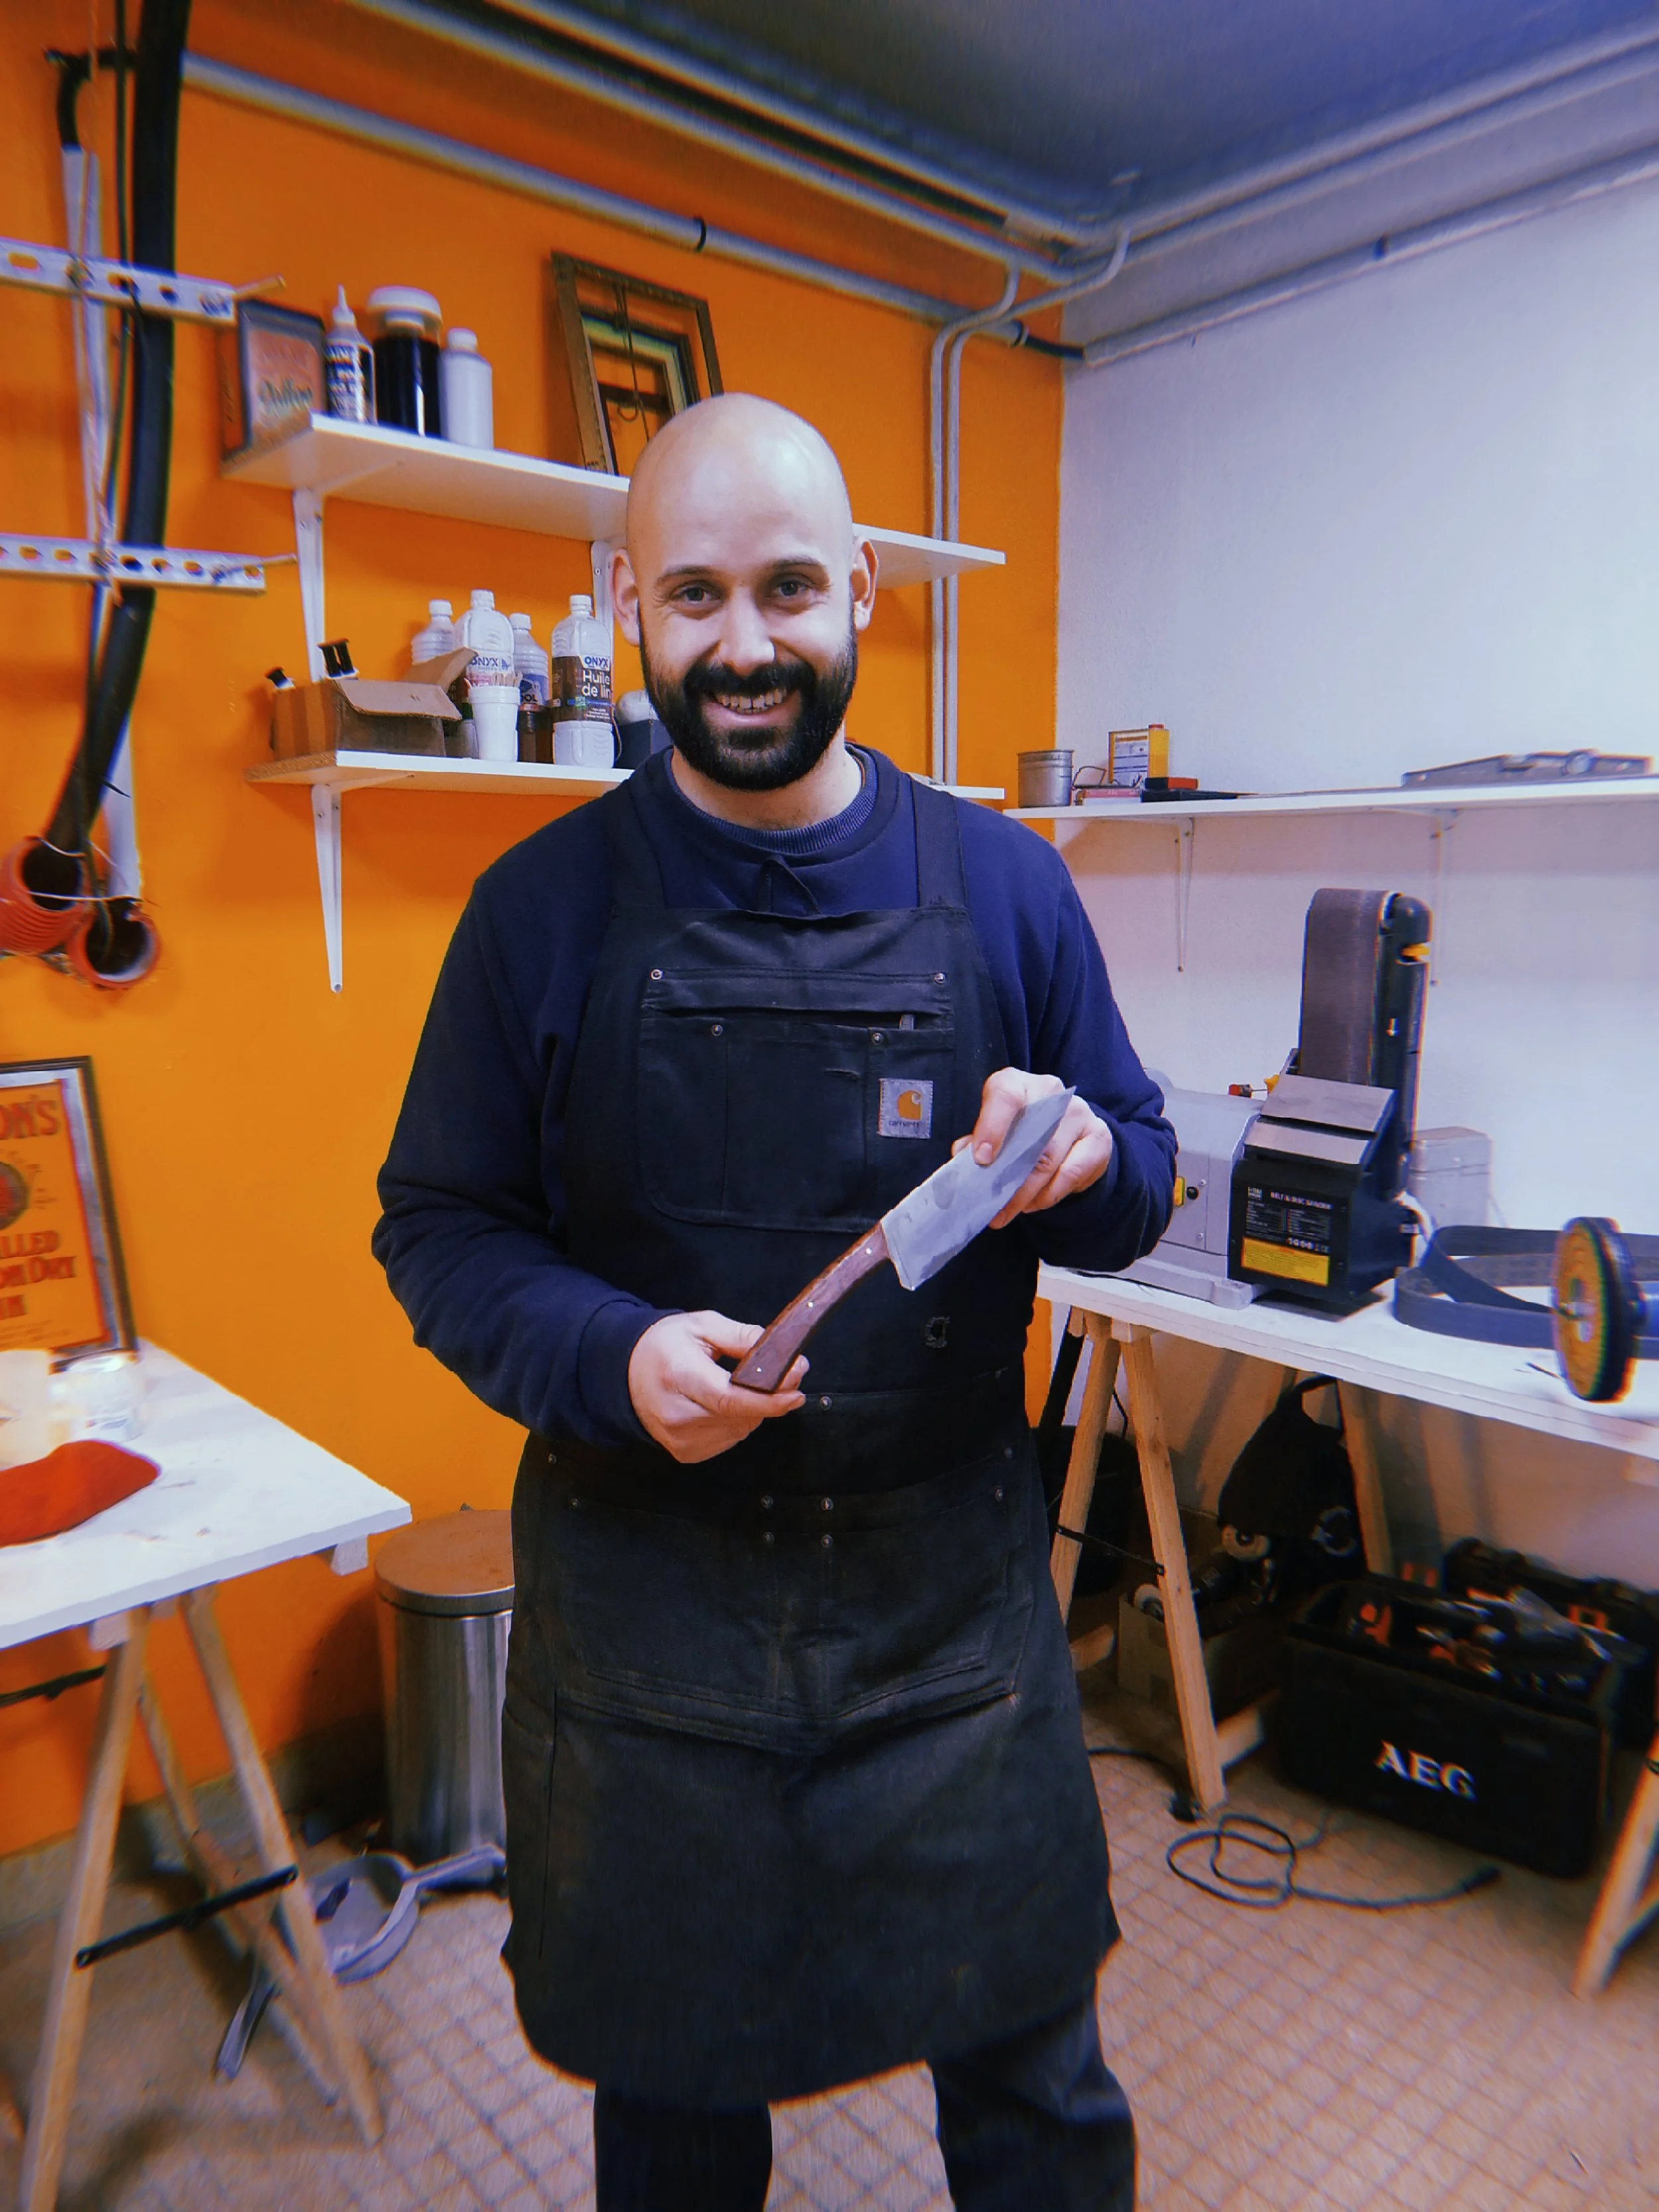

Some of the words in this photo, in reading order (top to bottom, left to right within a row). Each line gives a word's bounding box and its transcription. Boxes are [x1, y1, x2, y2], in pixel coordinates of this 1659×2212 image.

[469, 656, 498, 666] ONYX
[585, 656, 609, 668] ONYX
[583, 670, 611, 686] Huile
[581, 683, 598, 698] de
[600, 684, 611, 700] lin
[1373, 1740, 1477, 1801] AEG
